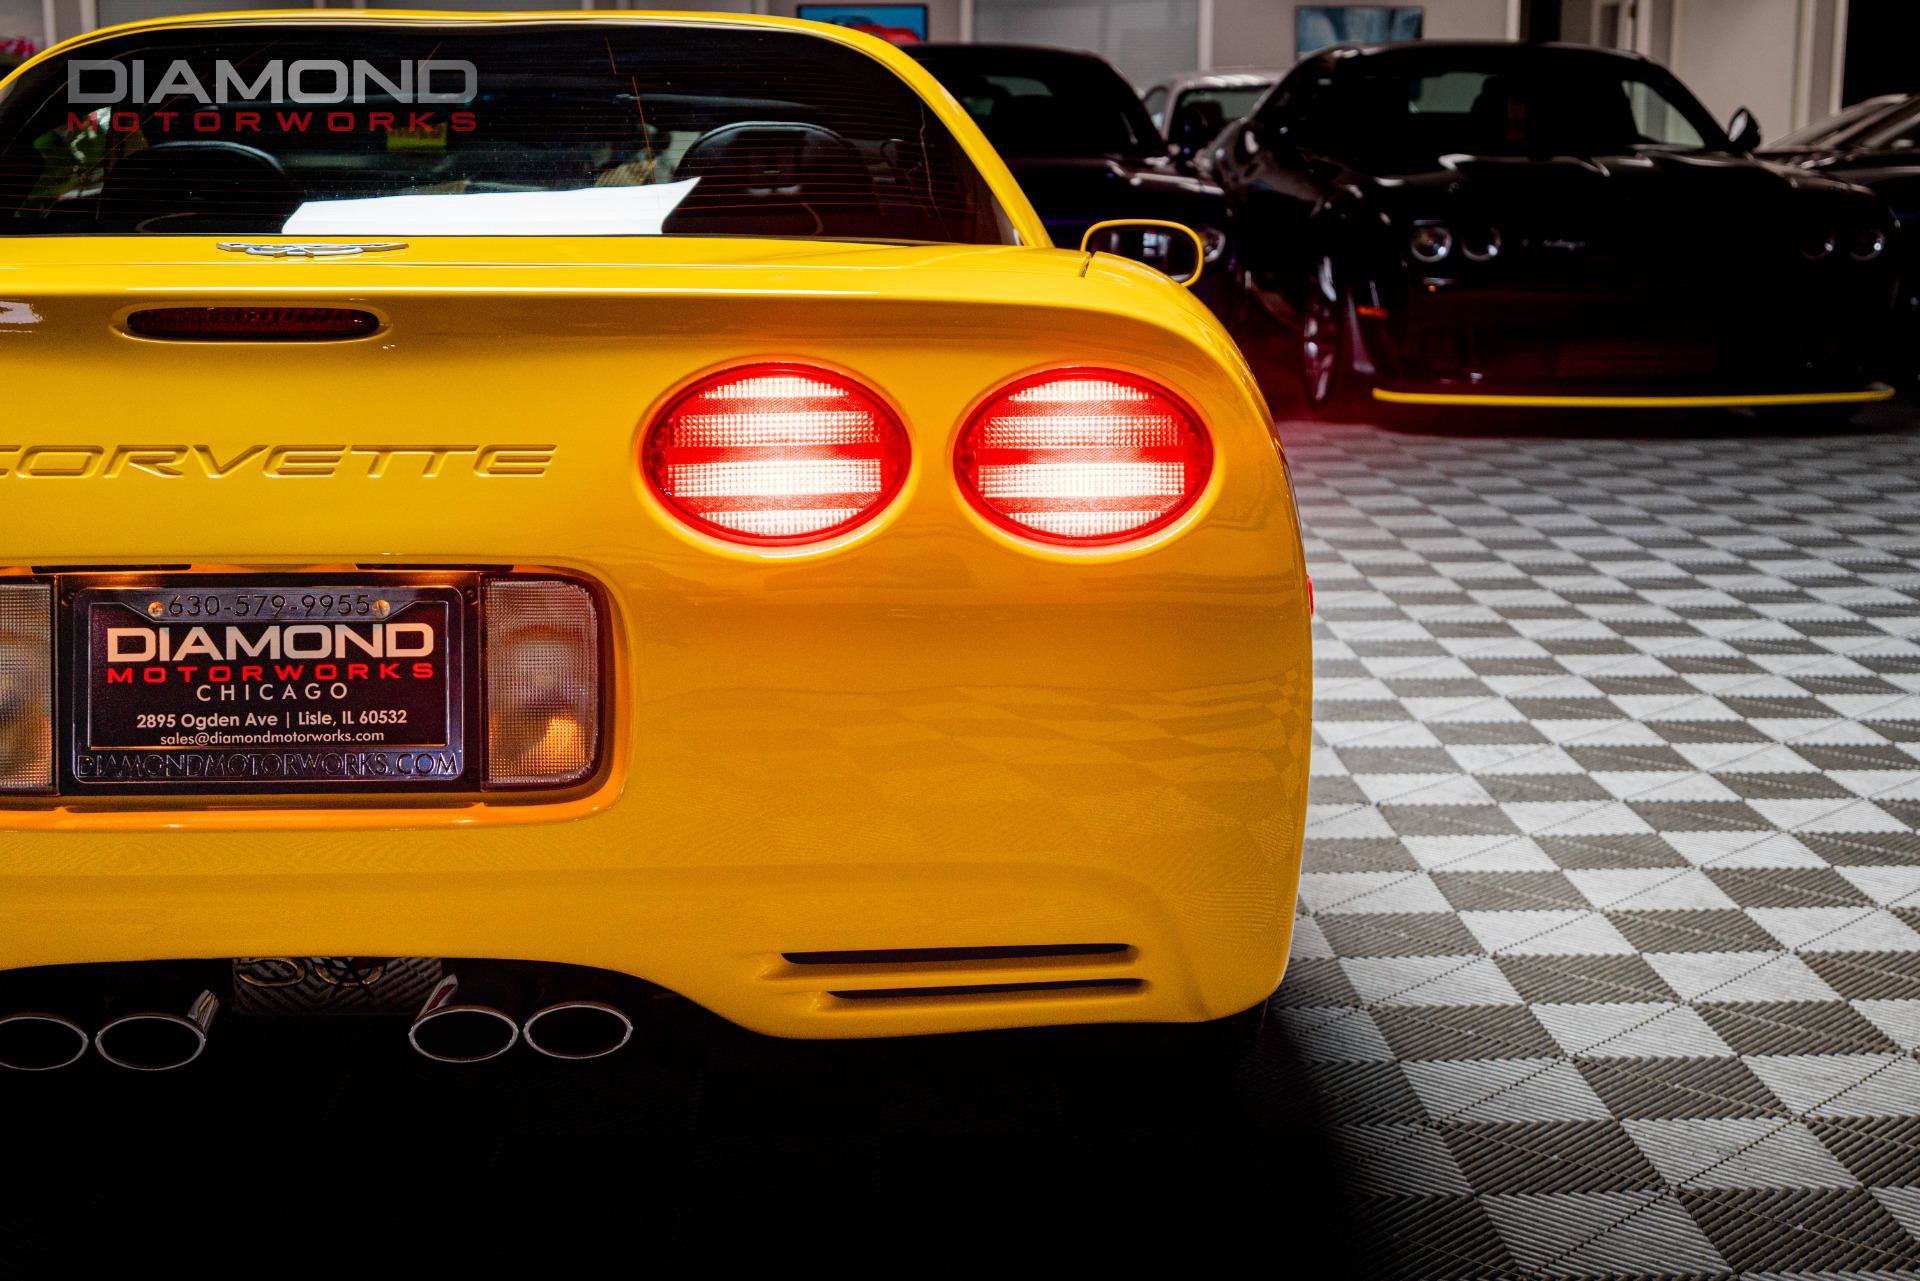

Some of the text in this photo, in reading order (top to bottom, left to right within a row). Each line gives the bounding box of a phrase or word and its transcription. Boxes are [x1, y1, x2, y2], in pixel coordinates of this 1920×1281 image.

[0, 444, 558, 478] ORVETTE
[168, 594, 371, 617] 630-579-9955
[107, 622, 434, 662] DIAMOND
[107, 662, 434, 685] MOTORWORKS
[196, 682, 348, 702] CHICAGO
[136, 713, 177, 729] 2895
[181, 712, 240, 730] Ogden
[244, 712, 279, 727] Ave
[298, 710, 337, 727] Lisle,
[342, 710, 355, 725] IL
[359, 709, 408, 725] 60532
[160, 729, 385, 746] sales@diamondmotorworks.com
[77, 752, 460, 777] DIAMONDMOTORWORKS.COM
